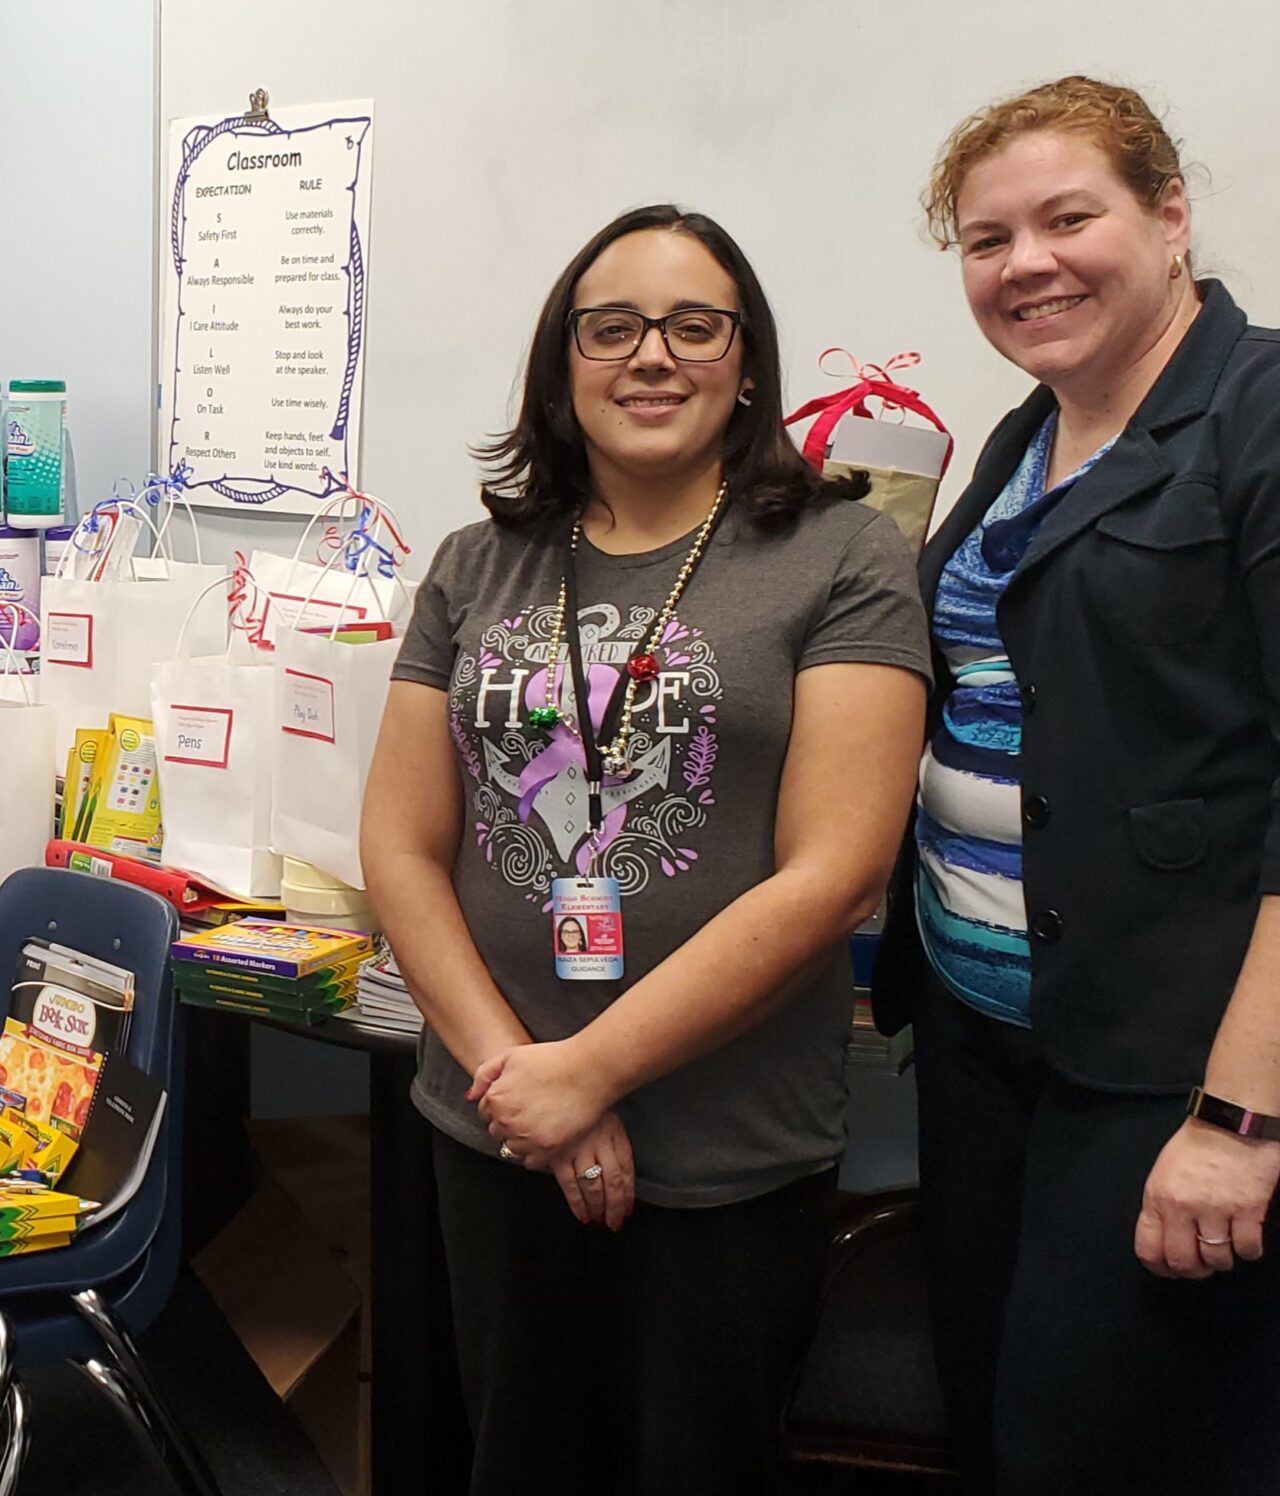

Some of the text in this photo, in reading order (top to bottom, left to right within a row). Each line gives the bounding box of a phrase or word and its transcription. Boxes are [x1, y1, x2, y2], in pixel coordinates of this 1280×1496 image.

[227, 151, 302, 171] Classroom
[195, 178, 323, 199] EXPECTATION RULE
[216, 213, 222, 223] S
[285, 208, 334, 220] Use materials
[198, 230, 237, 242] Safety First
[291, 225, 325, 236] correctly.
[213, 258, 220, 268] A
[280, 253, 334, 265] Be on time and
[187, 274, 254, 288] Always Responsible
[275, 271, 342, 284] prepared for class.
[278, 304, 333, 317] Always do your
[193, 322, 209, 332] Care
[210, 320, 239, 331] Attitude
[285, 319, 322, 330] best work.
[275, 350, 323, 361] Stop and look
[193, 364, 230, 375] Listen Well
[276, 365, 329, 377] at the speaker.
[207, 387, 213, 397] O
[197, 403, 224, 415] On Task
[271, 398, 328, 410] Use time wisely.
[204, 431, 210, 441] R
[265, 431, 324, 442] Keep hands, feet
[185, 446, 237, 459] Respect Others
[264, 446, 331, 457] and objects to self.
[264, 460, 319, 471] Use kind words.
[178, 734, 202, 749] Pens
[26, 959, 42, 970] PRINT
[221, 955, 248, 966] Assorted
[249, 959, 276, 971] Markers
[49, 993, 85, 1013] JUMBO
